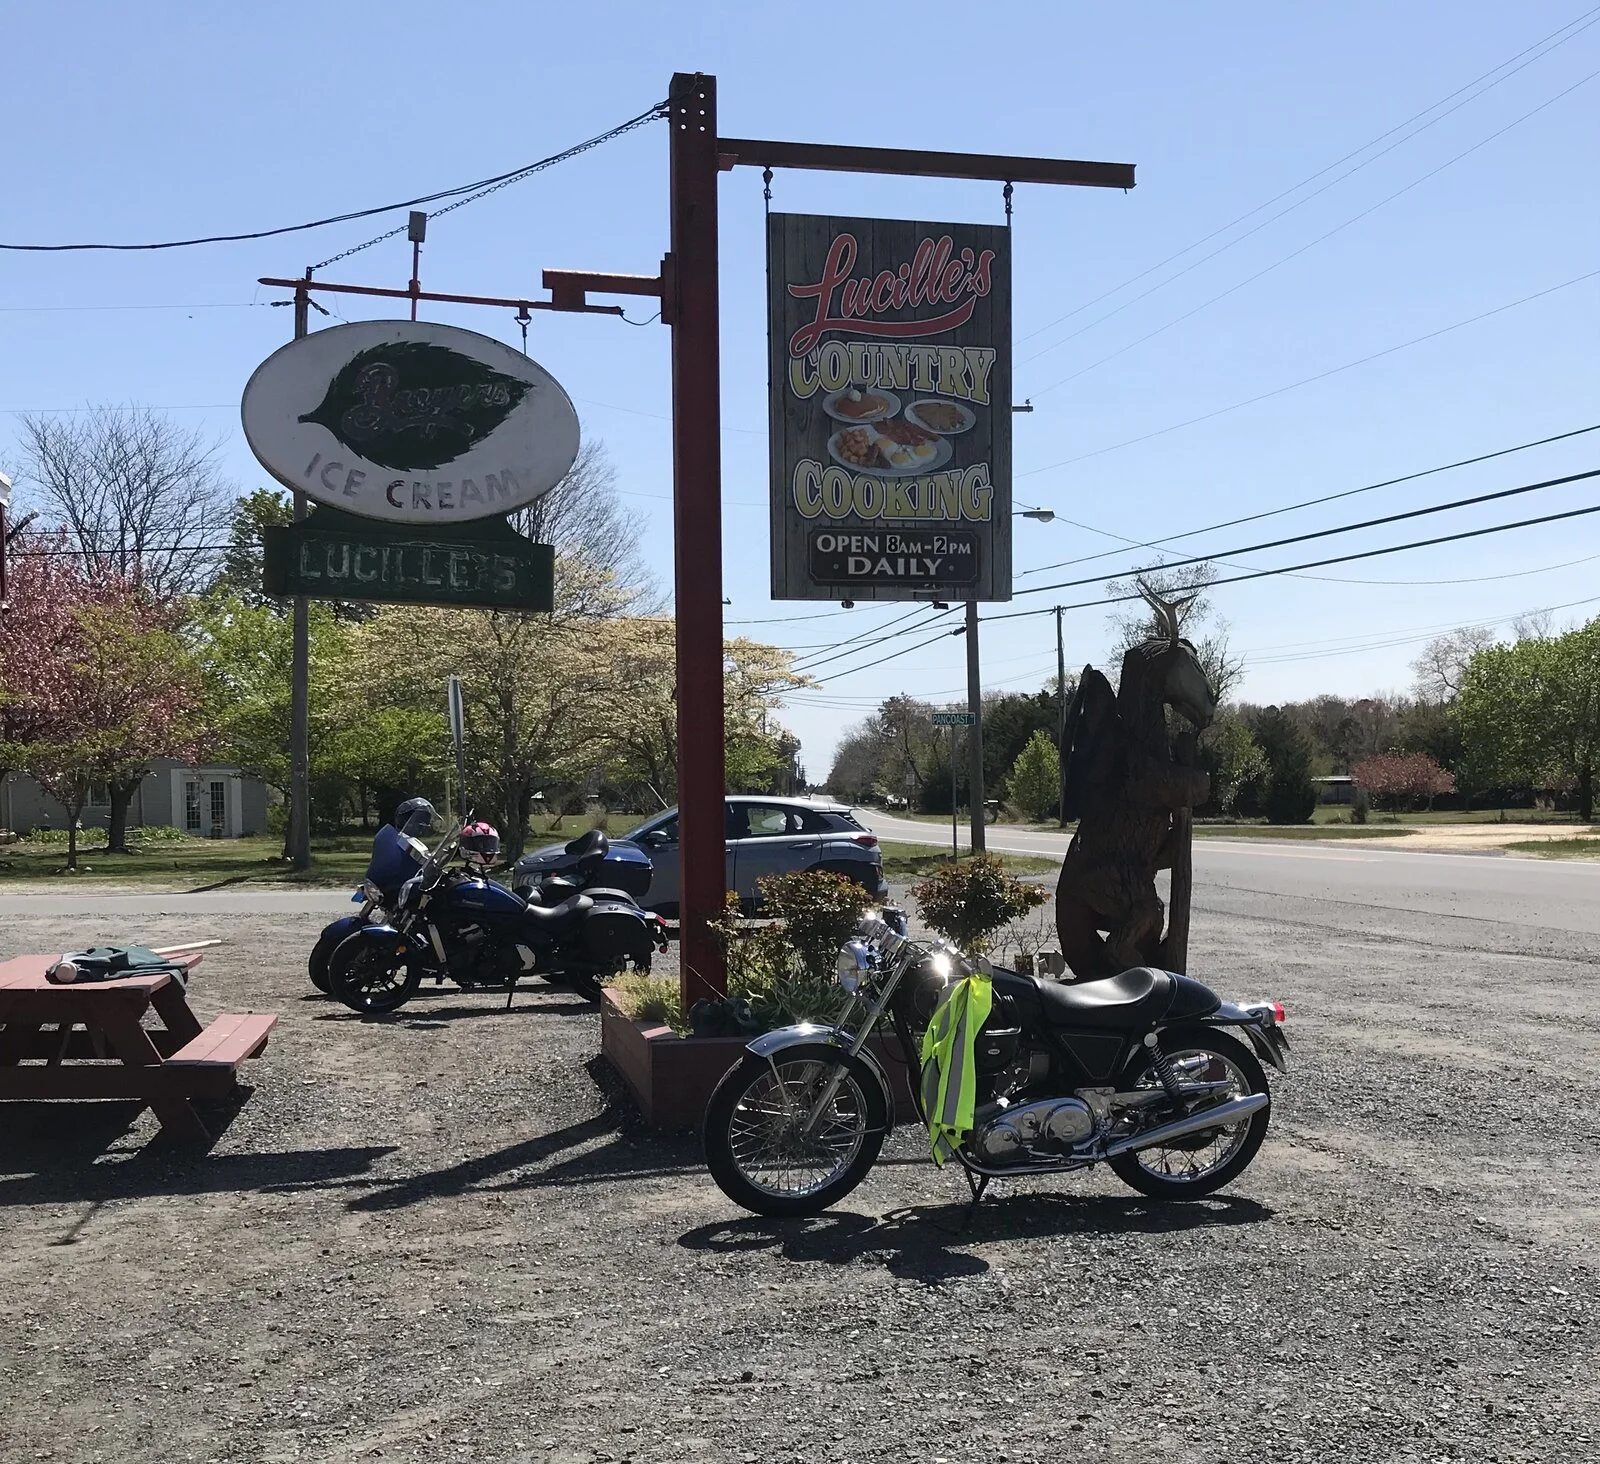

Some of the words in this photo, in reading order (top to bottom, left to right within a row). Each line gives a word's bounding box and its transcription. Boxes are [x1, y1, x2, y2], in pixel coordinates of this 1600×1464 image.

[788, 233, 996, 359] Lucille's
[788, 340, 997, 406] COUNTRY
[303, 453, 366, 498] ICE
[385, 469, 521, 511] CREAM
[793, 458, 994, 522] COOKING
[816, 534, 880, 554] OPEN
[847, 556, 944, 577] DAILY
[932, 714, 969, 725] PANCOAST
